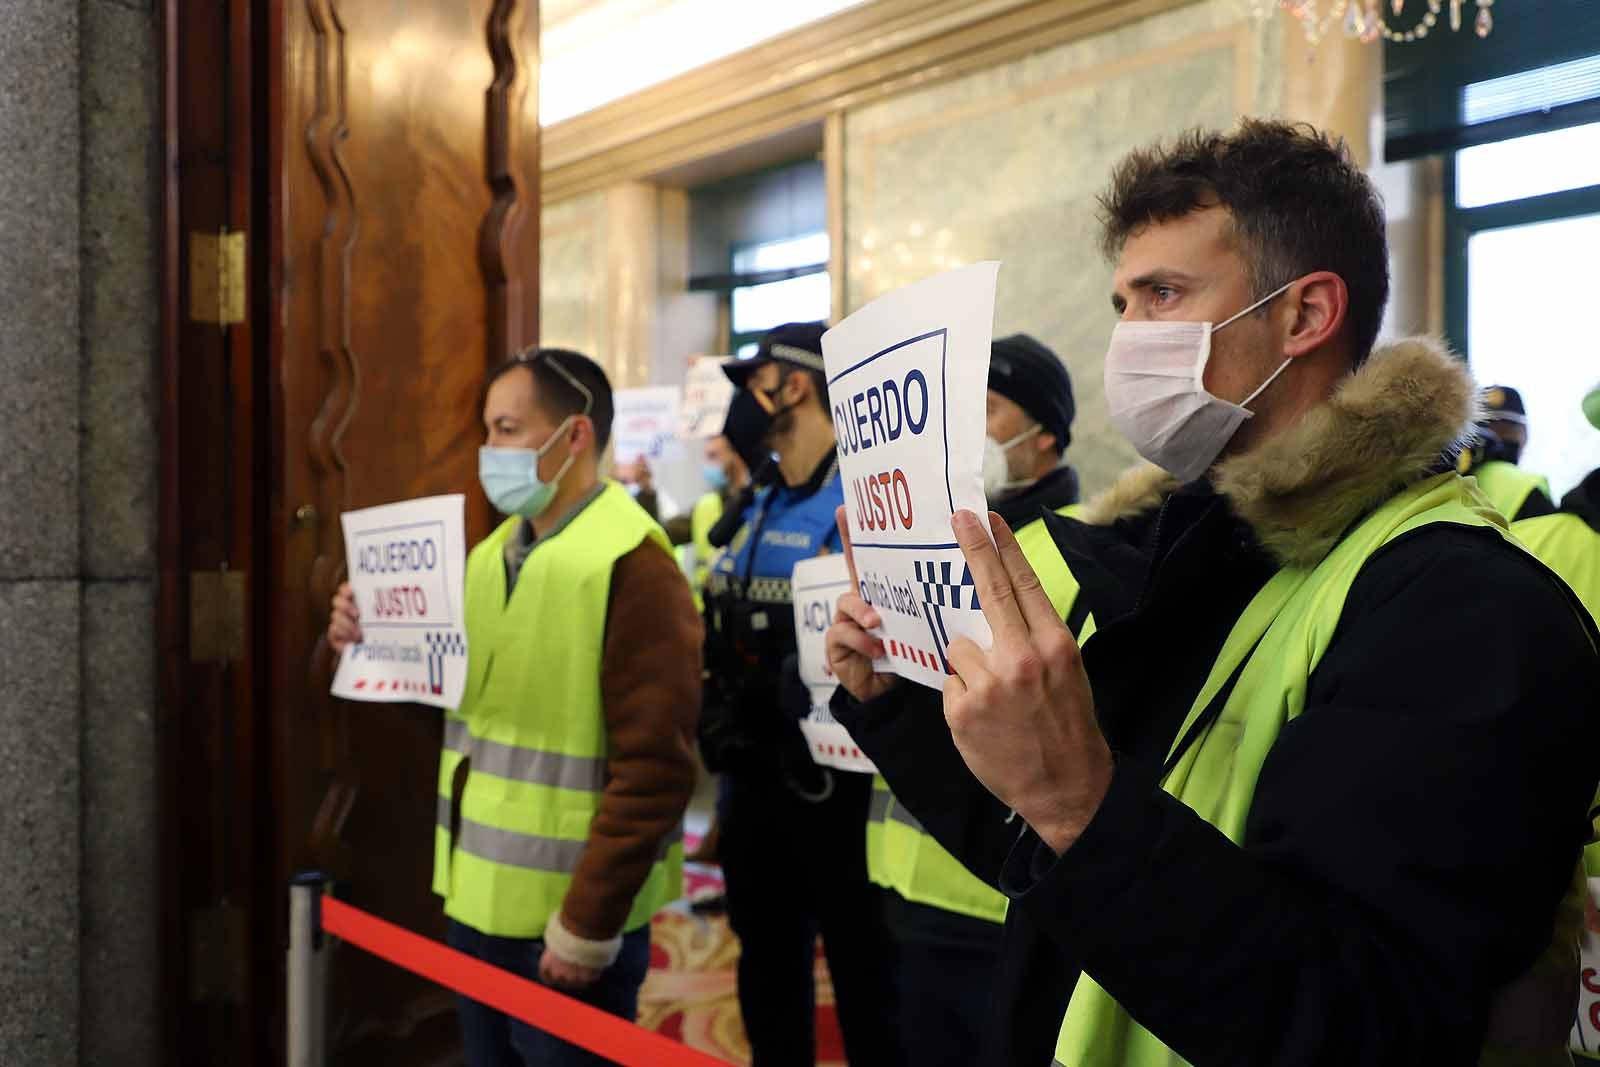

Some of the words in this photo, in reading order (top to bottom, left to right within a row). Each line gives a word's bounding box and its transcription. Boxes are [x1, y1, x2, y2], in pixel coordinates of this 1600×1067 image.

[835, 369, 929, 457] CUERDO
[853, 468, 913, 531] JUSTO
[357, 538, 437, 574] ACUERDO
[374, 585, 427, 617] JUSTO
